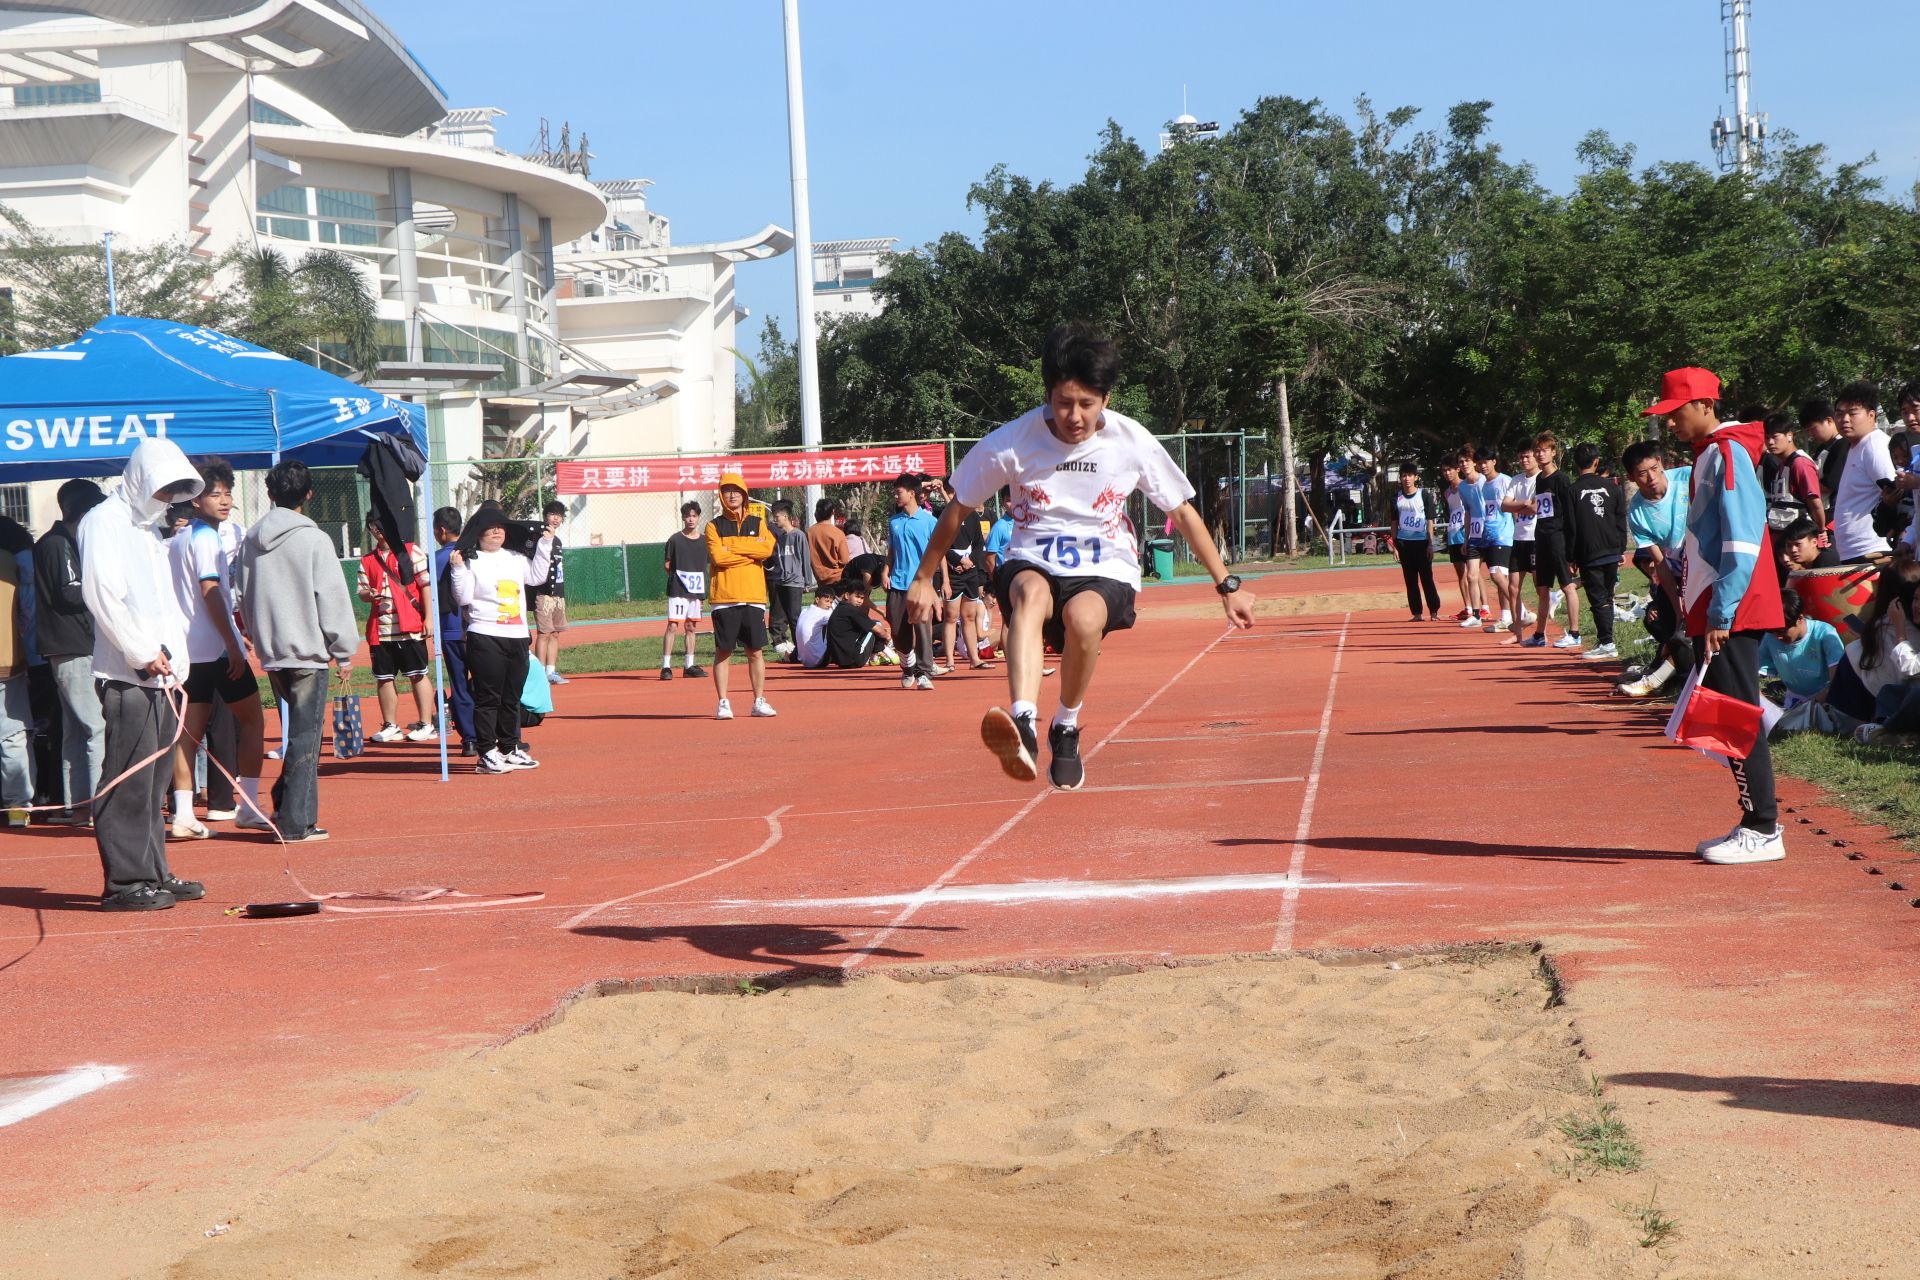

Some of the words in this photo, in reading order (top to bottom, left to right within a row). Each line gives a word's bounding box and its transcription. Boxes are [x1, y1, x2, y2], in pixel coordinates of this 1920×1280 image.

[6, 413, 175, 450] SWEAT
[581, 466, 650, 488] 只要拼
[769, 453, 925, 481] 成功就在不远处
[1056, 461, 1097, 473] CHOIZE
[1403, 515, 1421, 528] 488
[1449, 511, 1463, 526] 02
[1036, 536, 1101, 568] 751
[675, 604, 684, 615] 11
